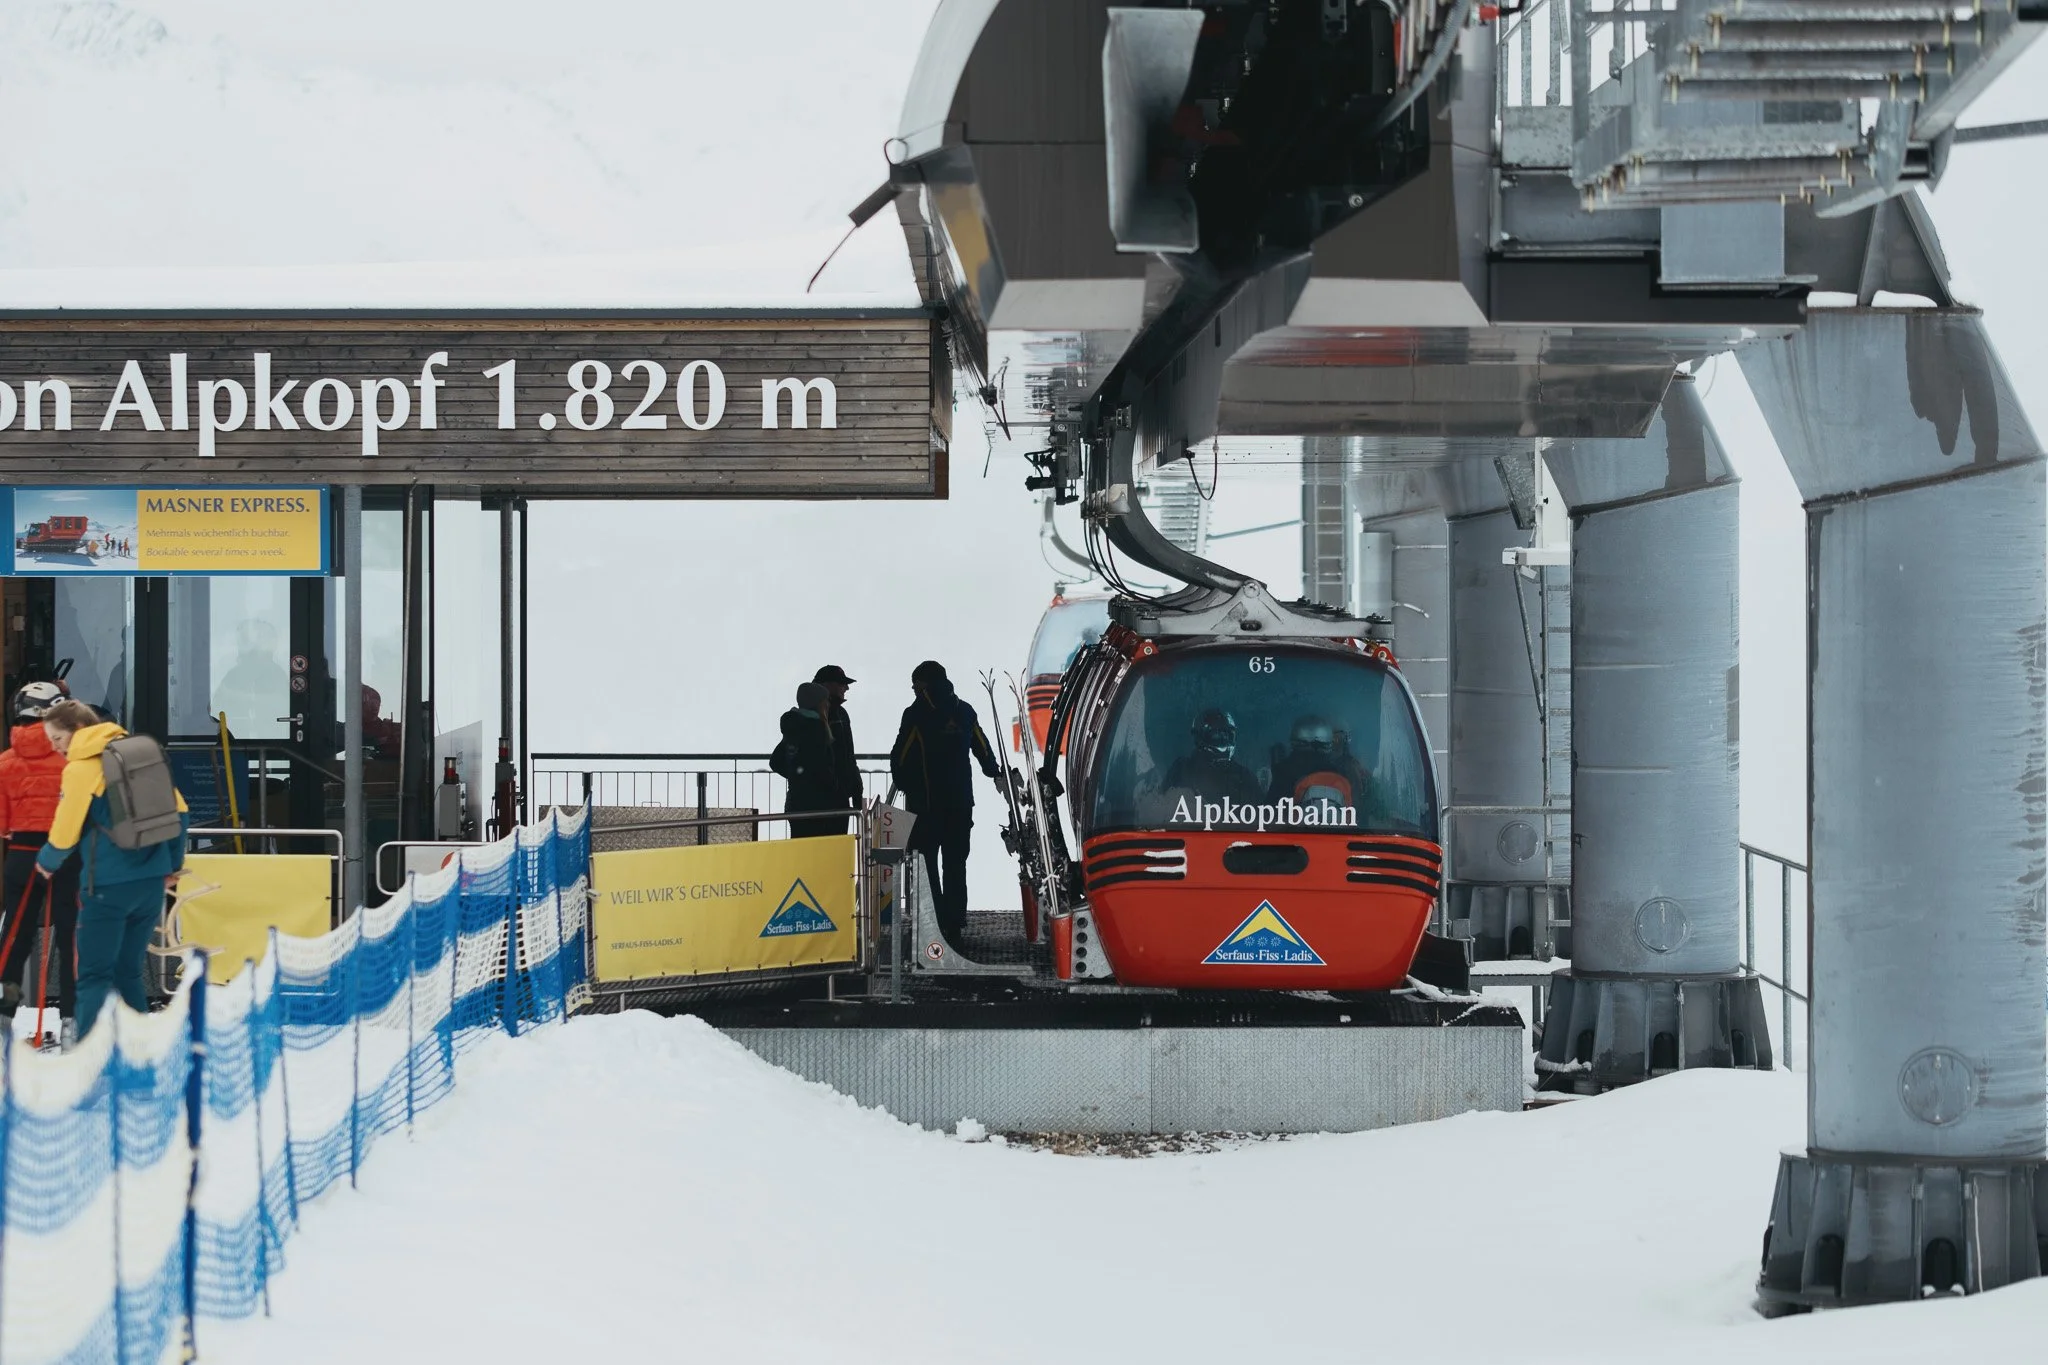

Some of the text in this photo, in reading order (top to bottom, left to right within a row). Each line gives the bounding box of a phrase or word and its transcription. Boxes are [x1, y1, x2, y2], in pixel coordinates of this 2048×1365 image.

[100, 352, 448, 457] Alpkopf
[482, 359, 727, 431] 1.820
[762, 377, 837, 429] m
[146, 498, 310, 513] MASNER EXPRESS.
[146, 528, 191, 538] Mehrmals
[194, 528, 249, 538] wöchentlich
[146, 547, 189, 557] Bookable
[191, 547, 223, 557] several
[225, 547, 249, 557] times
[1249, 656, 1275, 673] 65
[1170, 795, 1357, 832] Alpkopfbahn
[882, 811, 894, 883] STP
[610, 889, 644, 905] WEIL
[690, 880, 764, 900] GENIESSEN
